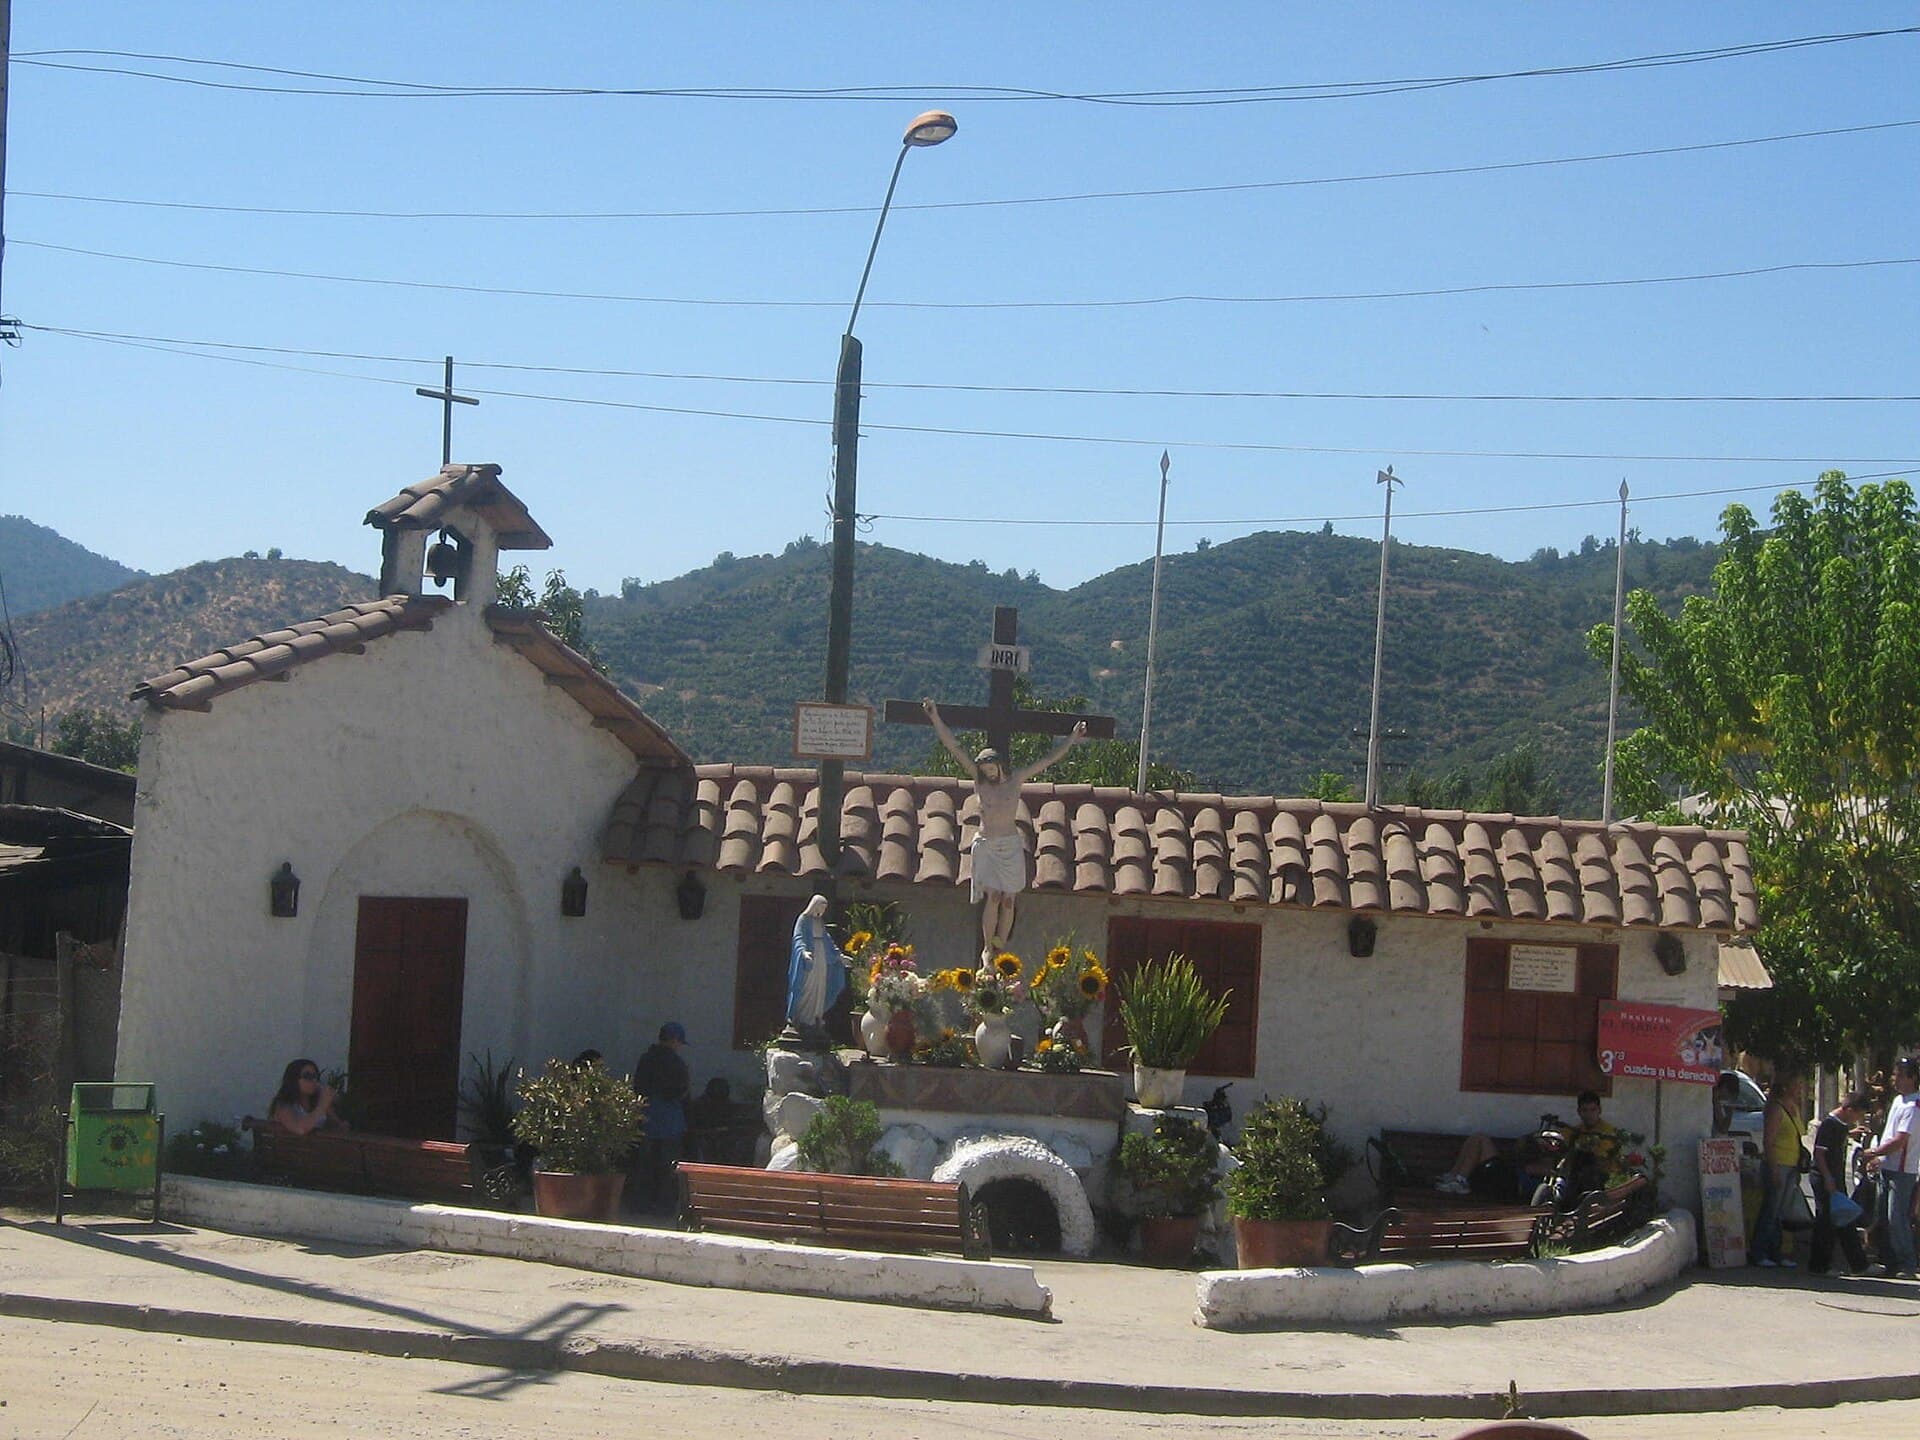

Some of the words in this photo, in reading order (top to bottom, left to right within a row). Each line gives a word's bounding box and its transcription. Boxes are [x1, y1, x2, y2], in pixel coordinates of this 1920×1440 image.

[992, 650, 1019, 666] INRI
[1624, 1064, 1656, 1075] cuadra
[1667, 1067, 1676, 1077] la
[1678, 1068, 1715, 1081] derecha
